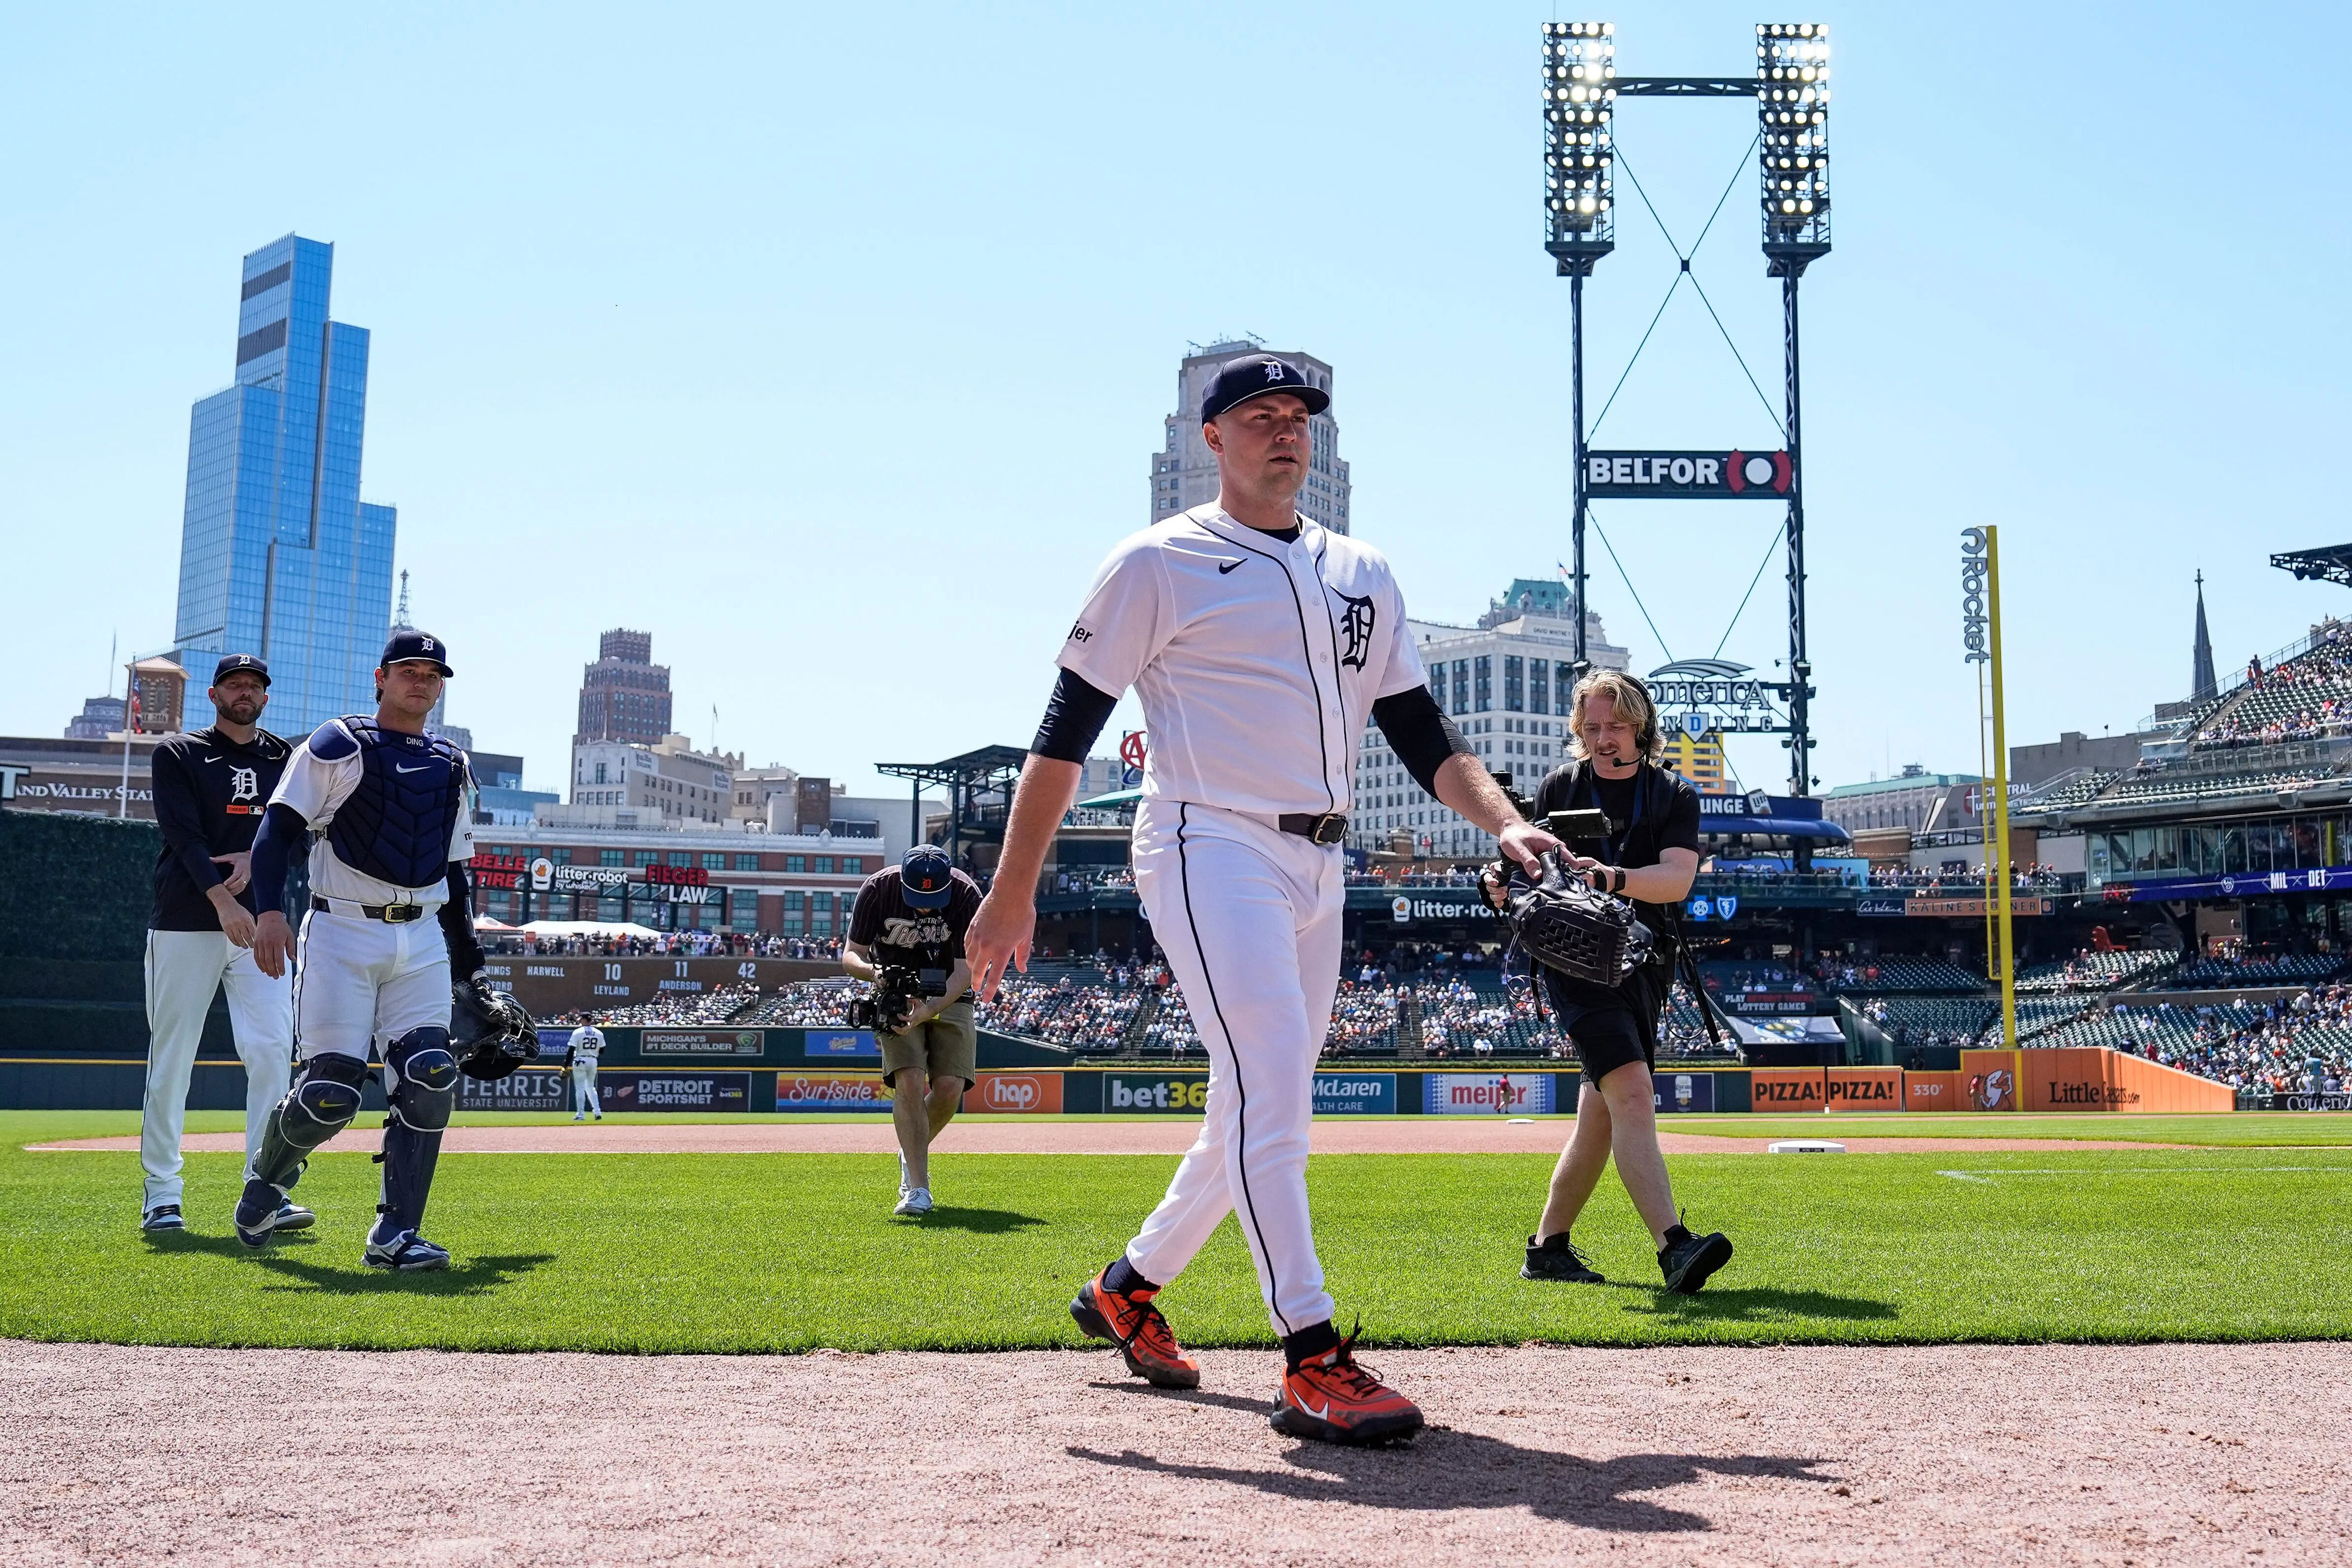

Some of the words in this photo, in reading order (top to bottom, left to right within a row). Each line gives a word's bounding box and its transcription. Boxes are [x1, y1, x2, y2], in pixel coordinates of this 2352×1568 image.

[1589, 457, 1720, 484] BELFOR
[1962, 557, 1989, 663] Rocket
[407, 737, 423, 747] DING
[48, 783, 114, 800] VALLEY
[470, 853, 527, 872] BELLE
[476, 870, 519, 888] TIRE
[646, 864, 709, 885] FIEGER
[2270, 872, 2288, 889] MIL
[2308, 870, 2326, 887] DET
[669, 885, 709, 904] LAW
[527, 966, 565, 977] HARWELL
[604, 963, 622, 981] 10
[675, 961, 688, 978] 11
[738, 962, 756, 979] 42
[594, 985, 630, 996] LEYLAND
[659, 980, 702, 991] ANDERSON
[1725, 994, 1745, 1003] PLAY
[1737, 1002, 1775, 1012] LOTTERY
[1778, 1002, 1806, 1011] GAMES
[583, 1037, 598, 1050] 28
[463, 1075, 563, 1097] FERRIS
[639, 1080, 714, 1094] DETROIT
[789, 1077, 872, 1102] Surfside
[994, 1078, 1034, 1109] hap
[1312, 1079, 1382, 1097] McLaren
[1755, 1081, 1822, 1101] PIZZA!
[1830, 1081, 1894, 1100] PIZZA!
[2049, 1081, 2099, 1104] Little
[462, 1098, 493, 1108] STATE
[497, 1098, 560, 1108] UNIVERSITY
[639, 1094, 714, 1104] SPORTSNET
[1338, 1102, 1363, 1111] CARE
